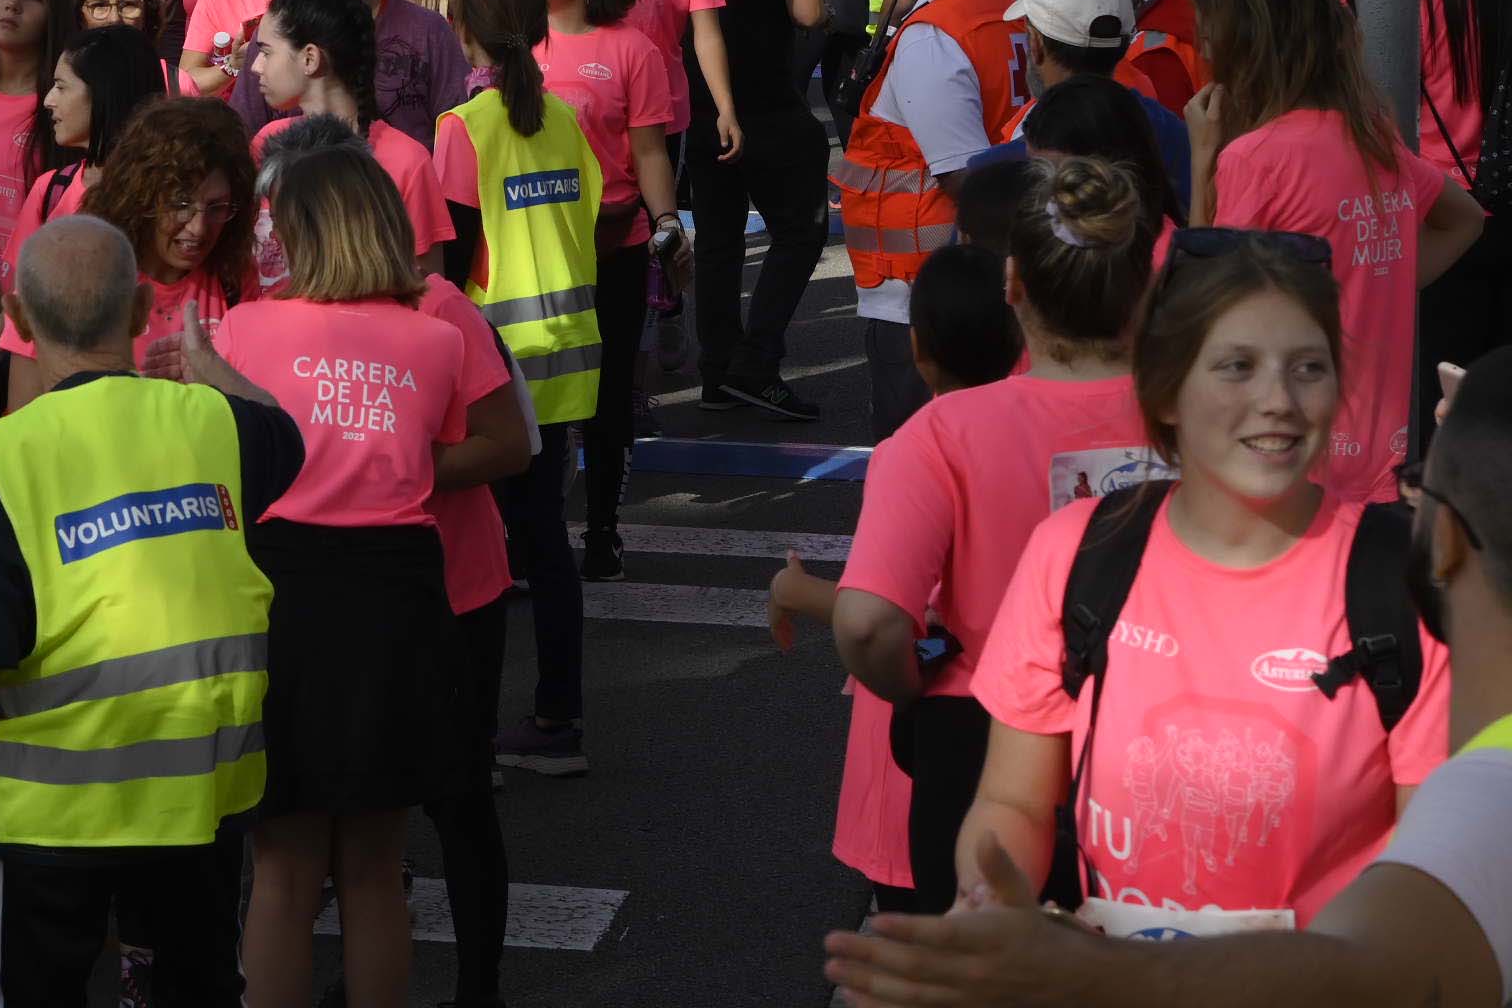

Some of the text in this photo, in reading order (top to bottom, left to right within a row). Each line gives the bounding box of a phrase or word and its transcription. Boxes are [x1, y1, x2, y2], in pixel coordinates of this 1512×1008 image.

[292, 355, 418, 392] CARRERA
[317, 380, 393, 410] DE LA
[309, 403, 397, 433] MUJER
[342, 431, 366, 442] 2023
[58, 494, 221, 550] VOLUNTARIS
